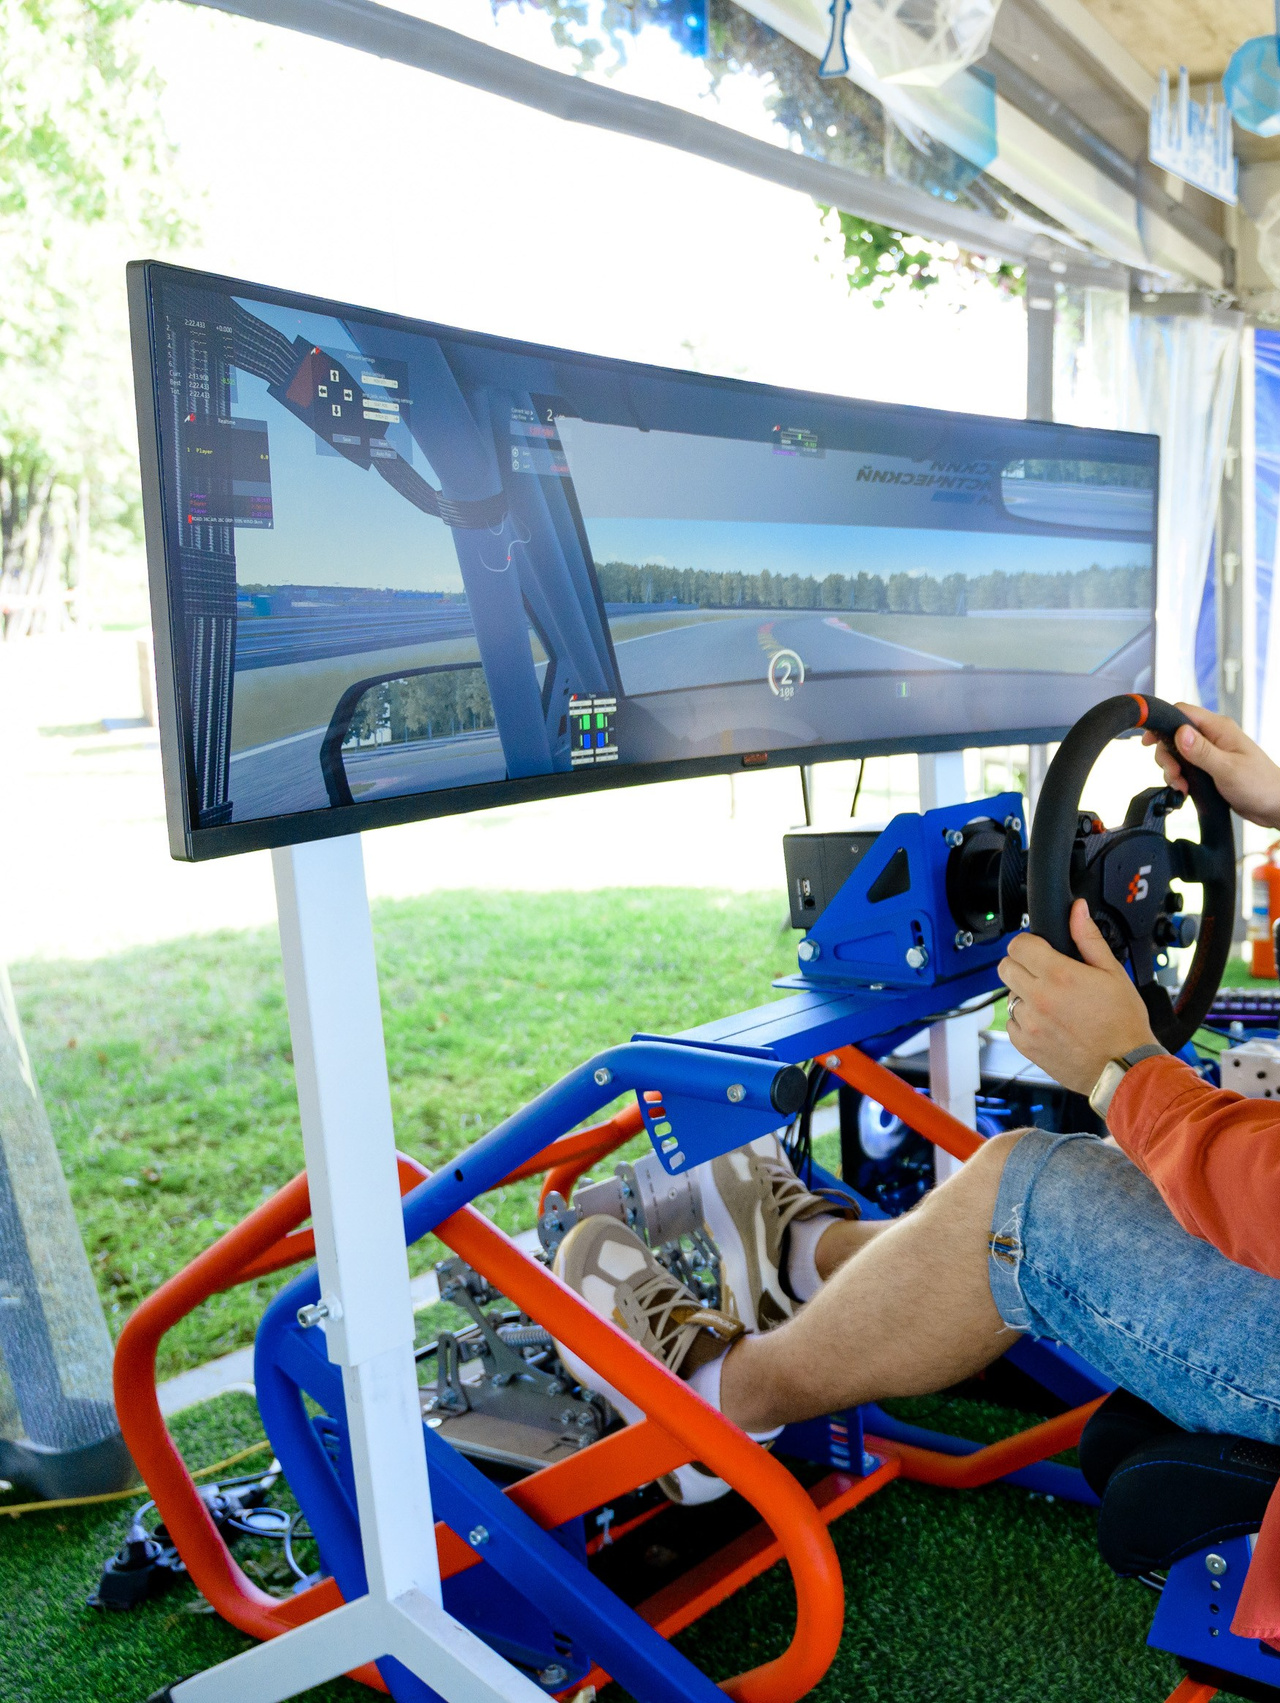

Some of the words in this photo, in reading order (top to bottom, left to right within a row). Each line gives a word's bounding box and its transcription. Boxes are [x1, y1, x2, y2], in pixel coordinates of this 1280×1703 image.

[546, 408, 554, 422] 2
[196, 447, 213, 455] Player
[781, 661, 793, 685] 2
